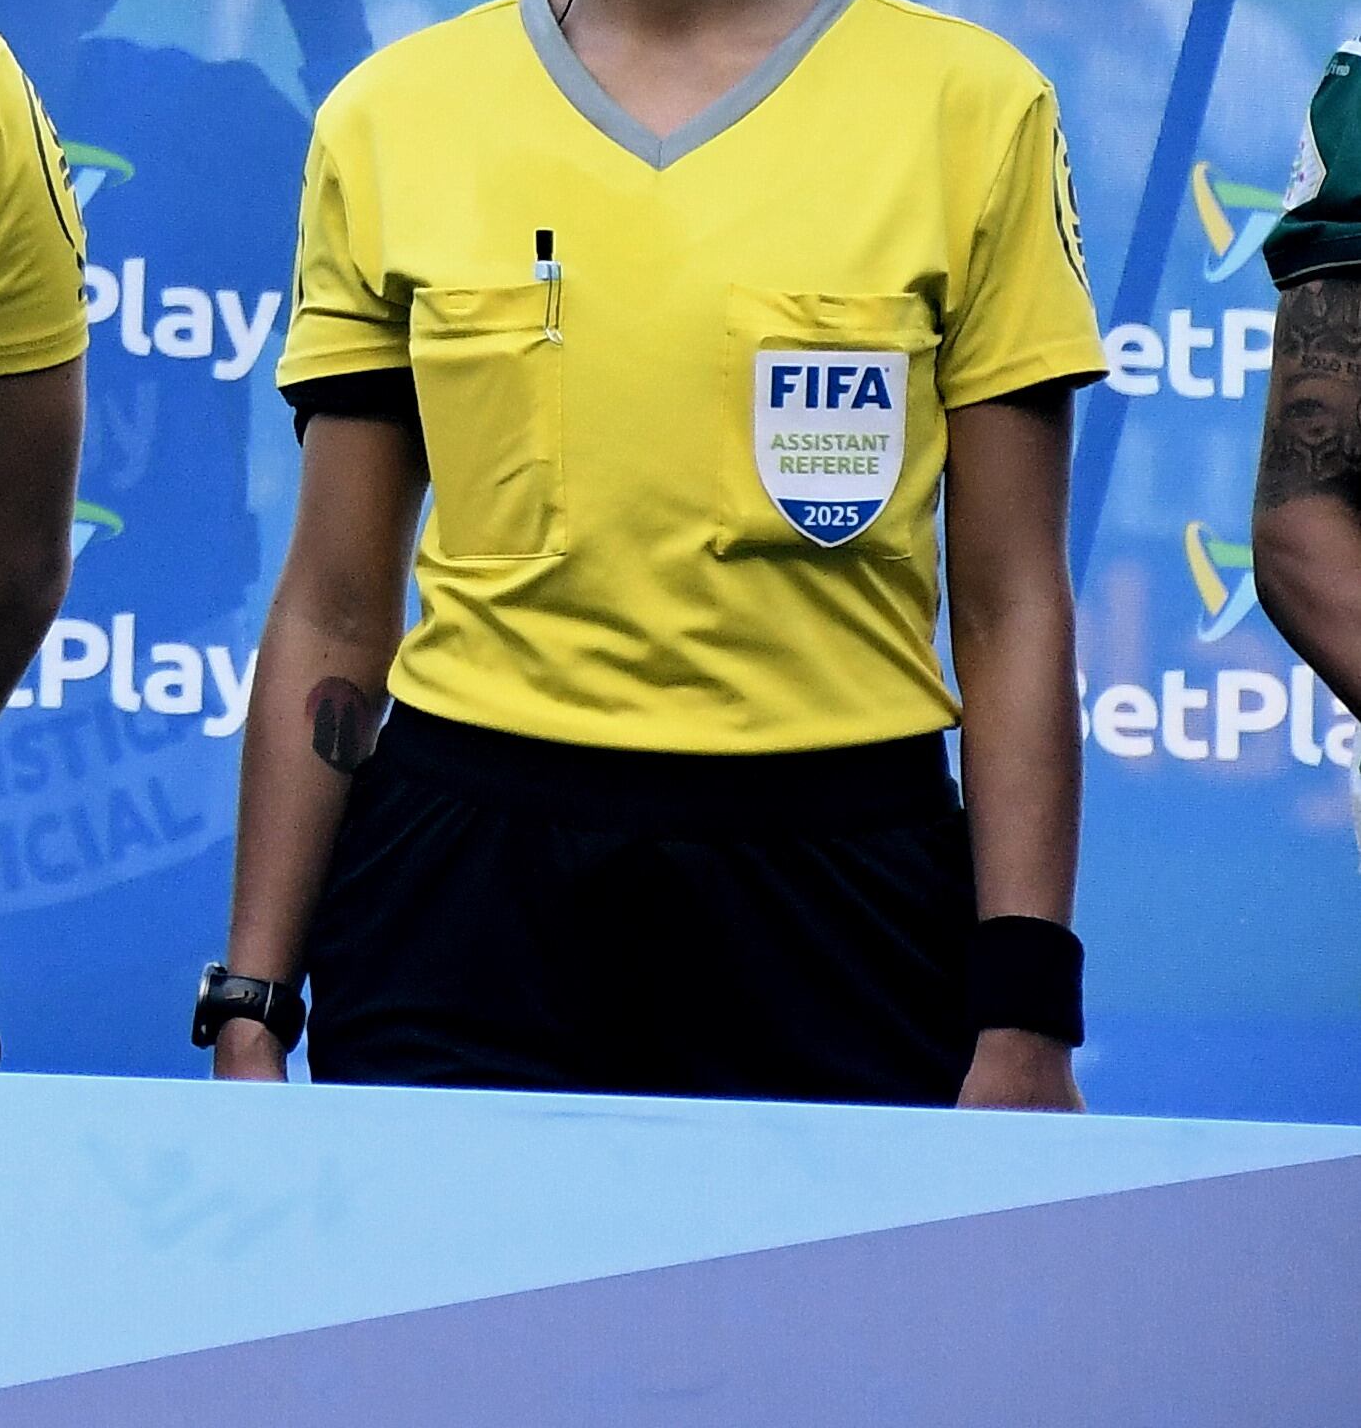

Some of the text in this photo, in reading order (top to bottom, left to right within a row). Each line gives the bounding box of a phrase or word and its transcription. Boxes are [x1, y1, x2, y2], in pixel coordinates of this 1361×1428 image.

[770, 365, 892, 409] FIFA
[771, 433, 891, 453] ASSISTANT
[779, 456, 881, 475] REFEREE
[803, 506, 860, 526] 2025
[7, 613, 258, 738] Play
